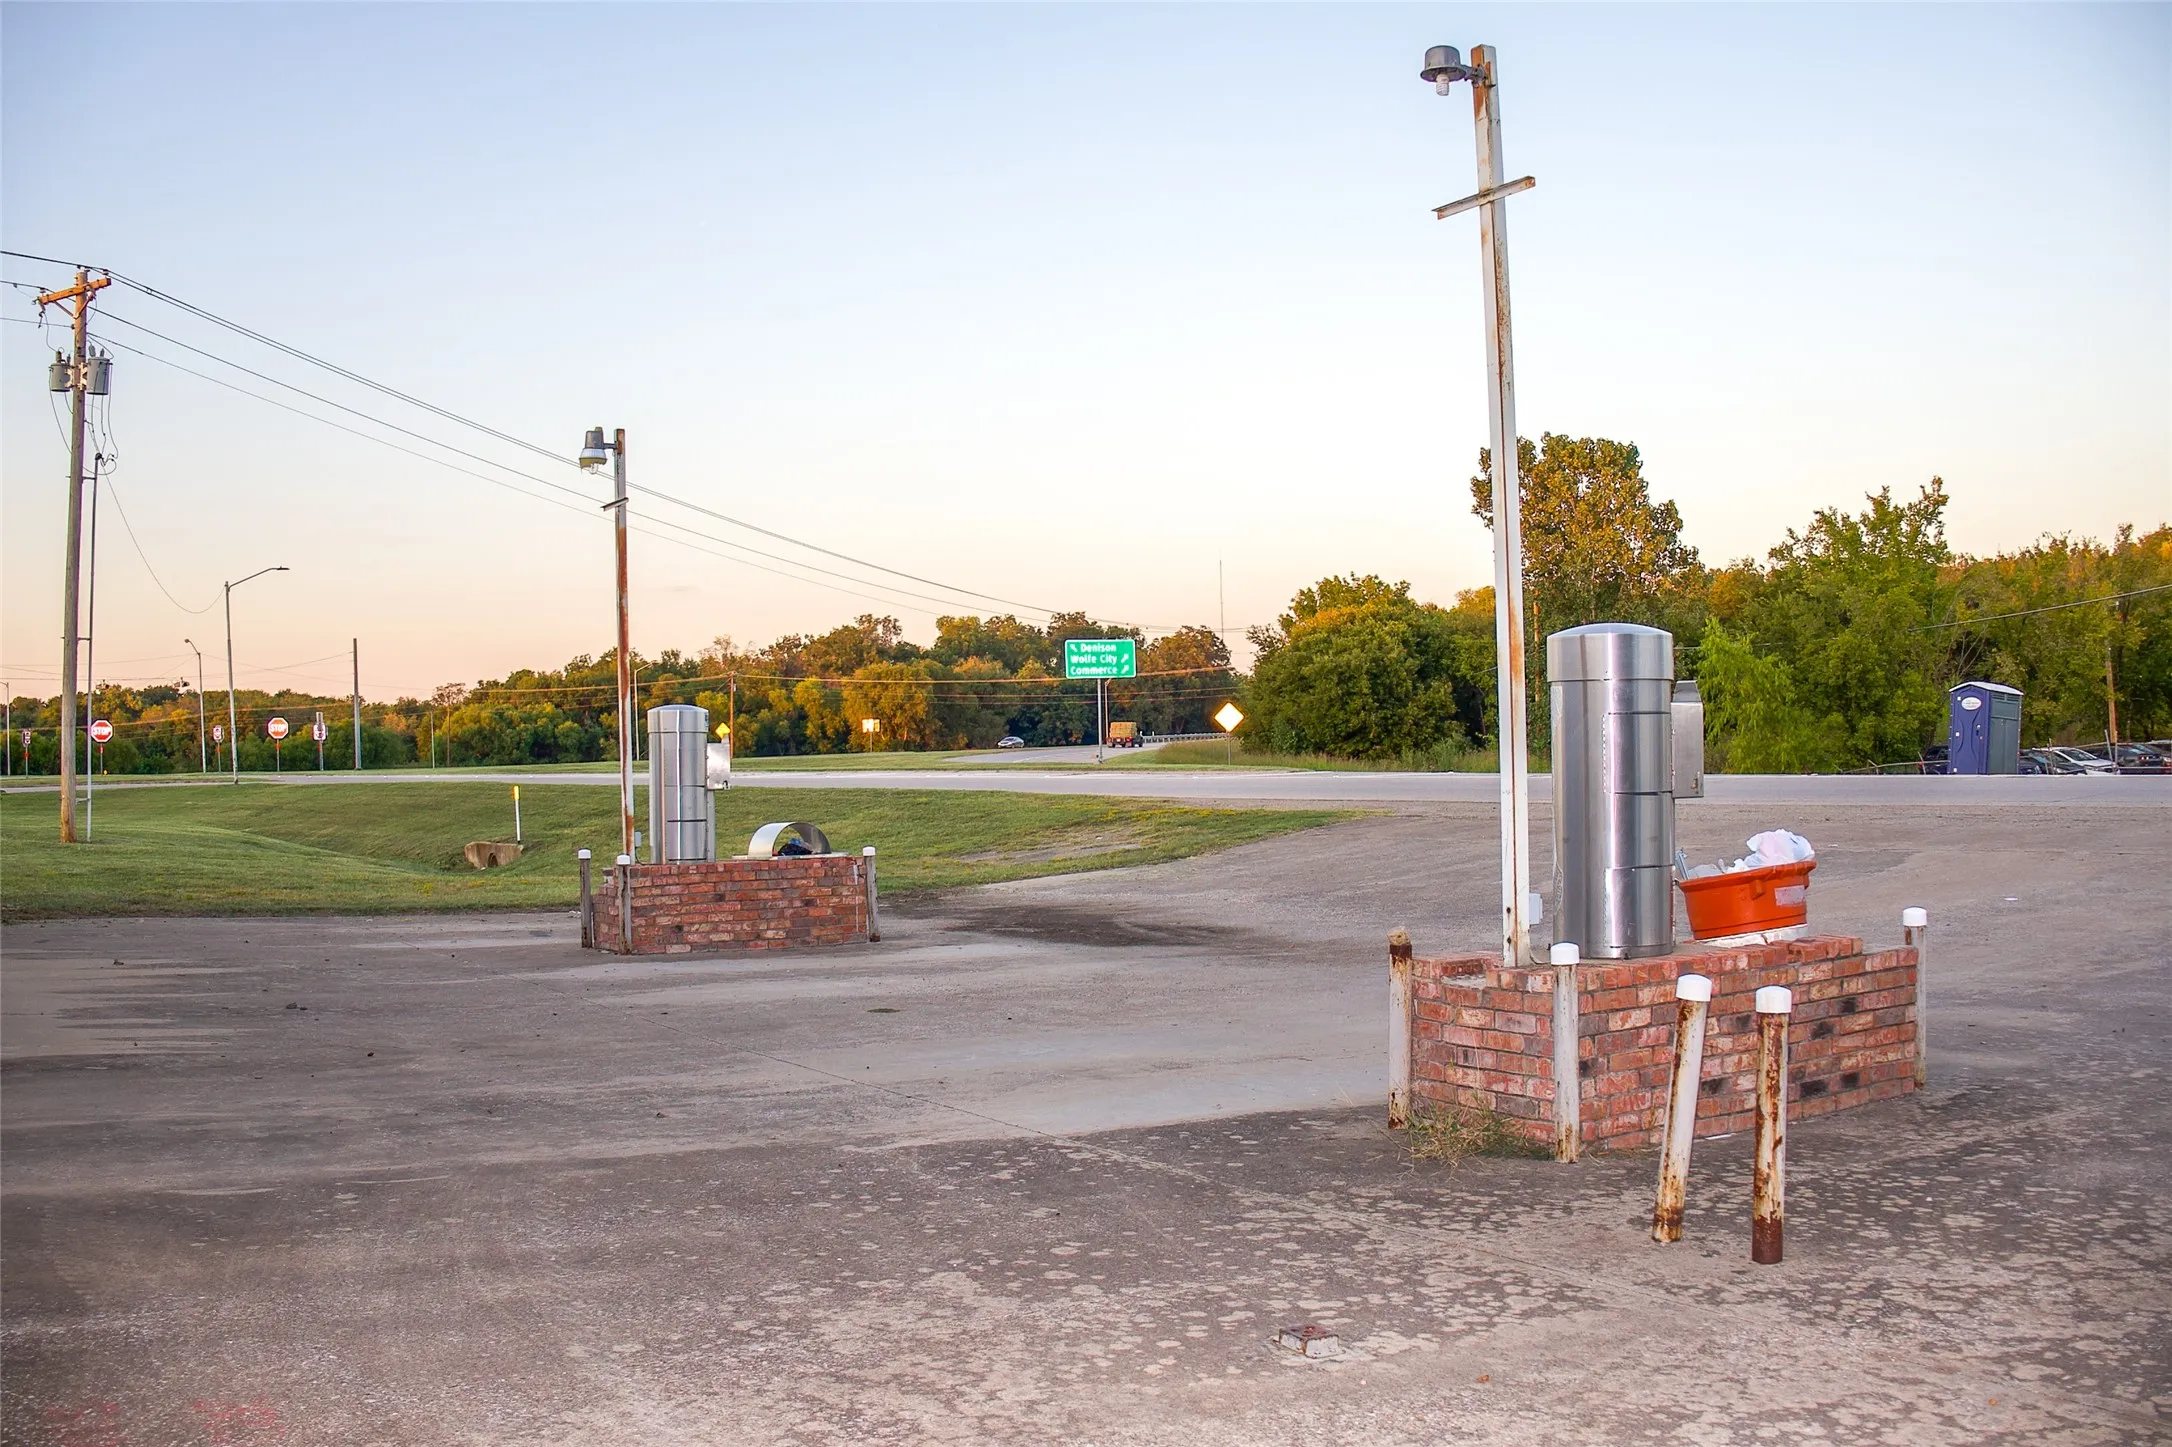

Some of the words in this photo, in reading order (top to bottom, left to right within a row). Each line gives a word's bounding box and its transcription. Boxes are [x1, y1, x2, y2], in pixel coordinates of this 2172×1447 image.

[1080, 643, 1116, 652] Denison
[1100, 653, 1117, 665] City
[1070, 666, 1117, 675] Commerce
[93, 726, 111, 736] STOP
[270, 723, 287, 733] STOP
